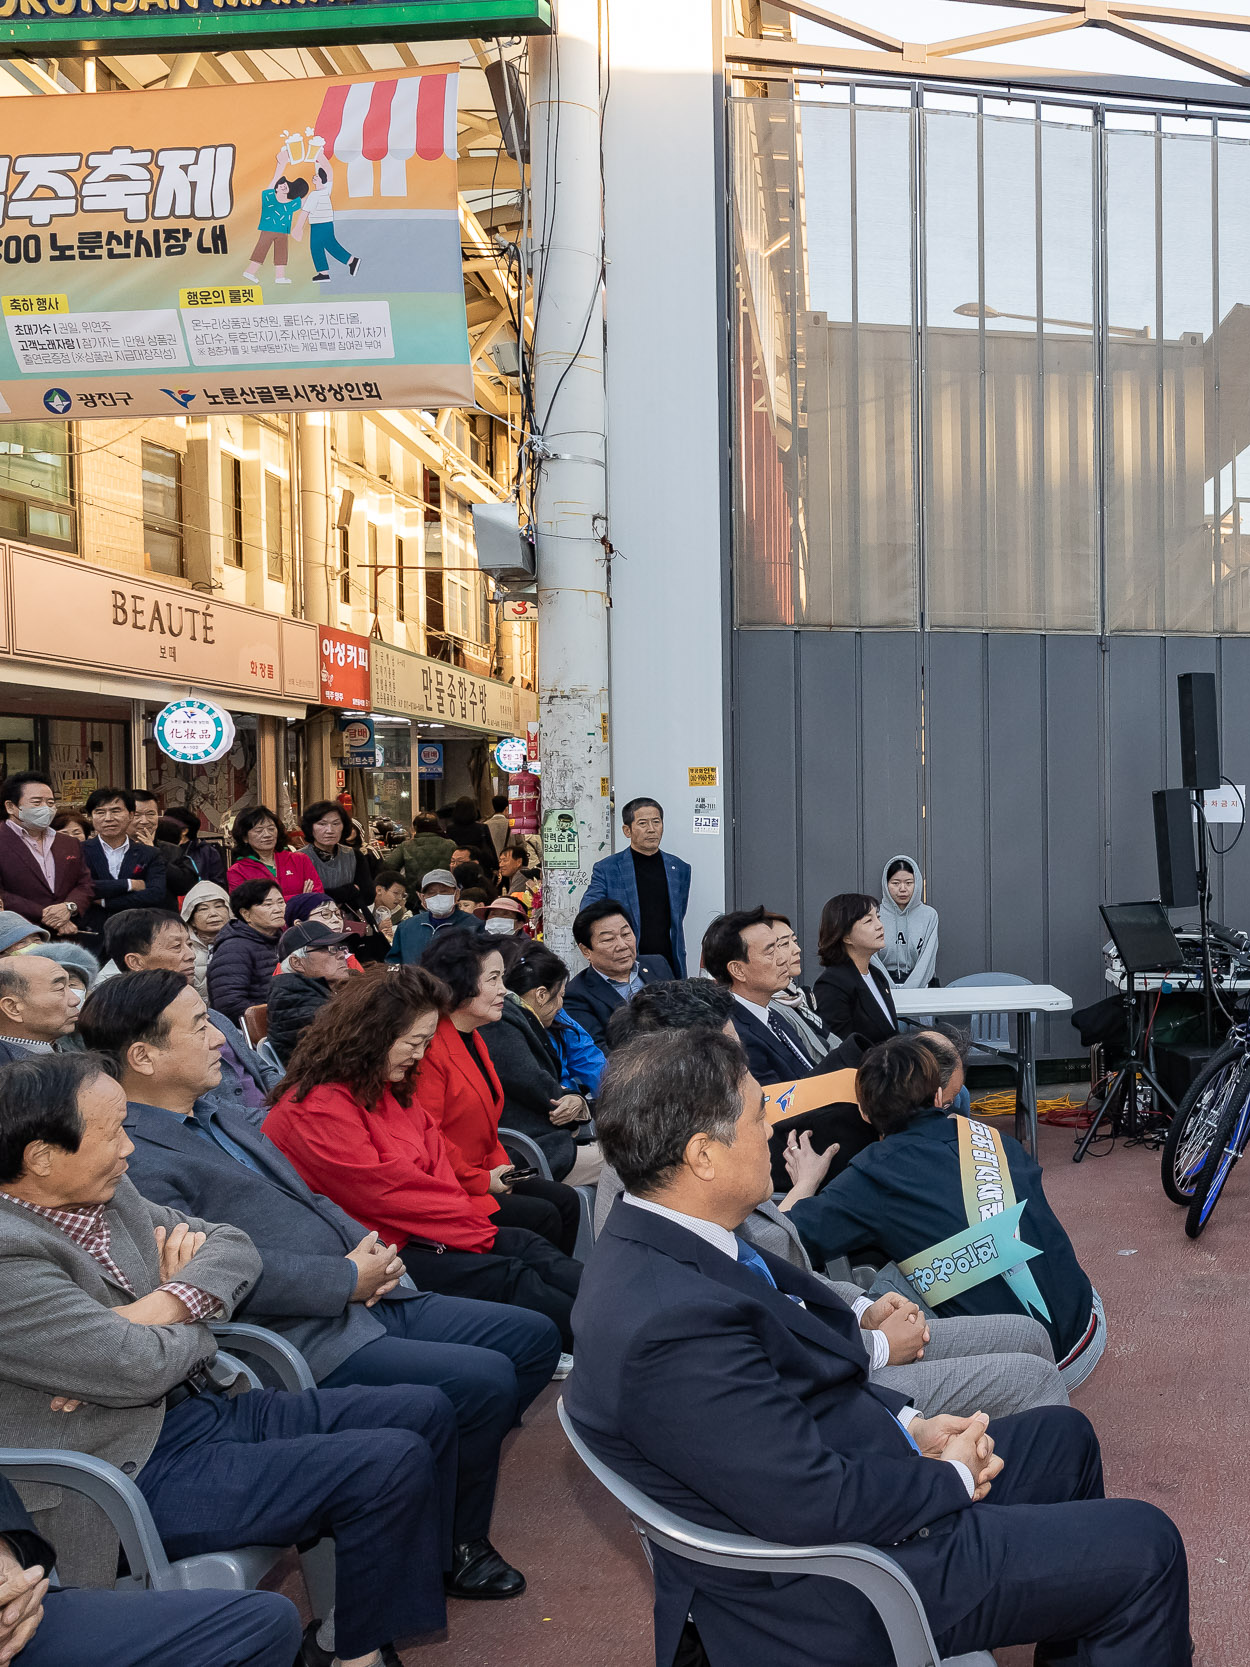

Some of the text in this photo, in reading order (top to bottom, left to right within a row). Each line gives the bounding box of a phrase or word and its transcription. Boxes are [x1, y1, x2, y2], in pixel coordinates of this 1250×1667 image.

[0, 143, 236, 227] 주축제
[49, 228, 193, 262] 노룬산시장
[196, 224, 228, 255] 내
[9, 296, 59, 313] 축하 행사
[186, 288, 254, 306] 행운의 룰렛
[14, 324, 52, 336] 초대가수
[191, 317, 251, 331] 온누리상품권
[345, 327, 387, 338] 제기차기
[18, 339, 75, 351] 고객노래자랑
[147, 334, 177, 347] 상품권
[76, 391, 134, 408] 광진구
[202, 381, 383, 406] 노룬산골목시장상인회
[111, 589, 216, 645] BEAUTÉ
[322, 638, 369, 672] 아성커피
[421, 665, 488, 725] 만물종합주방
[694, 817, 719, 828] 김고철
